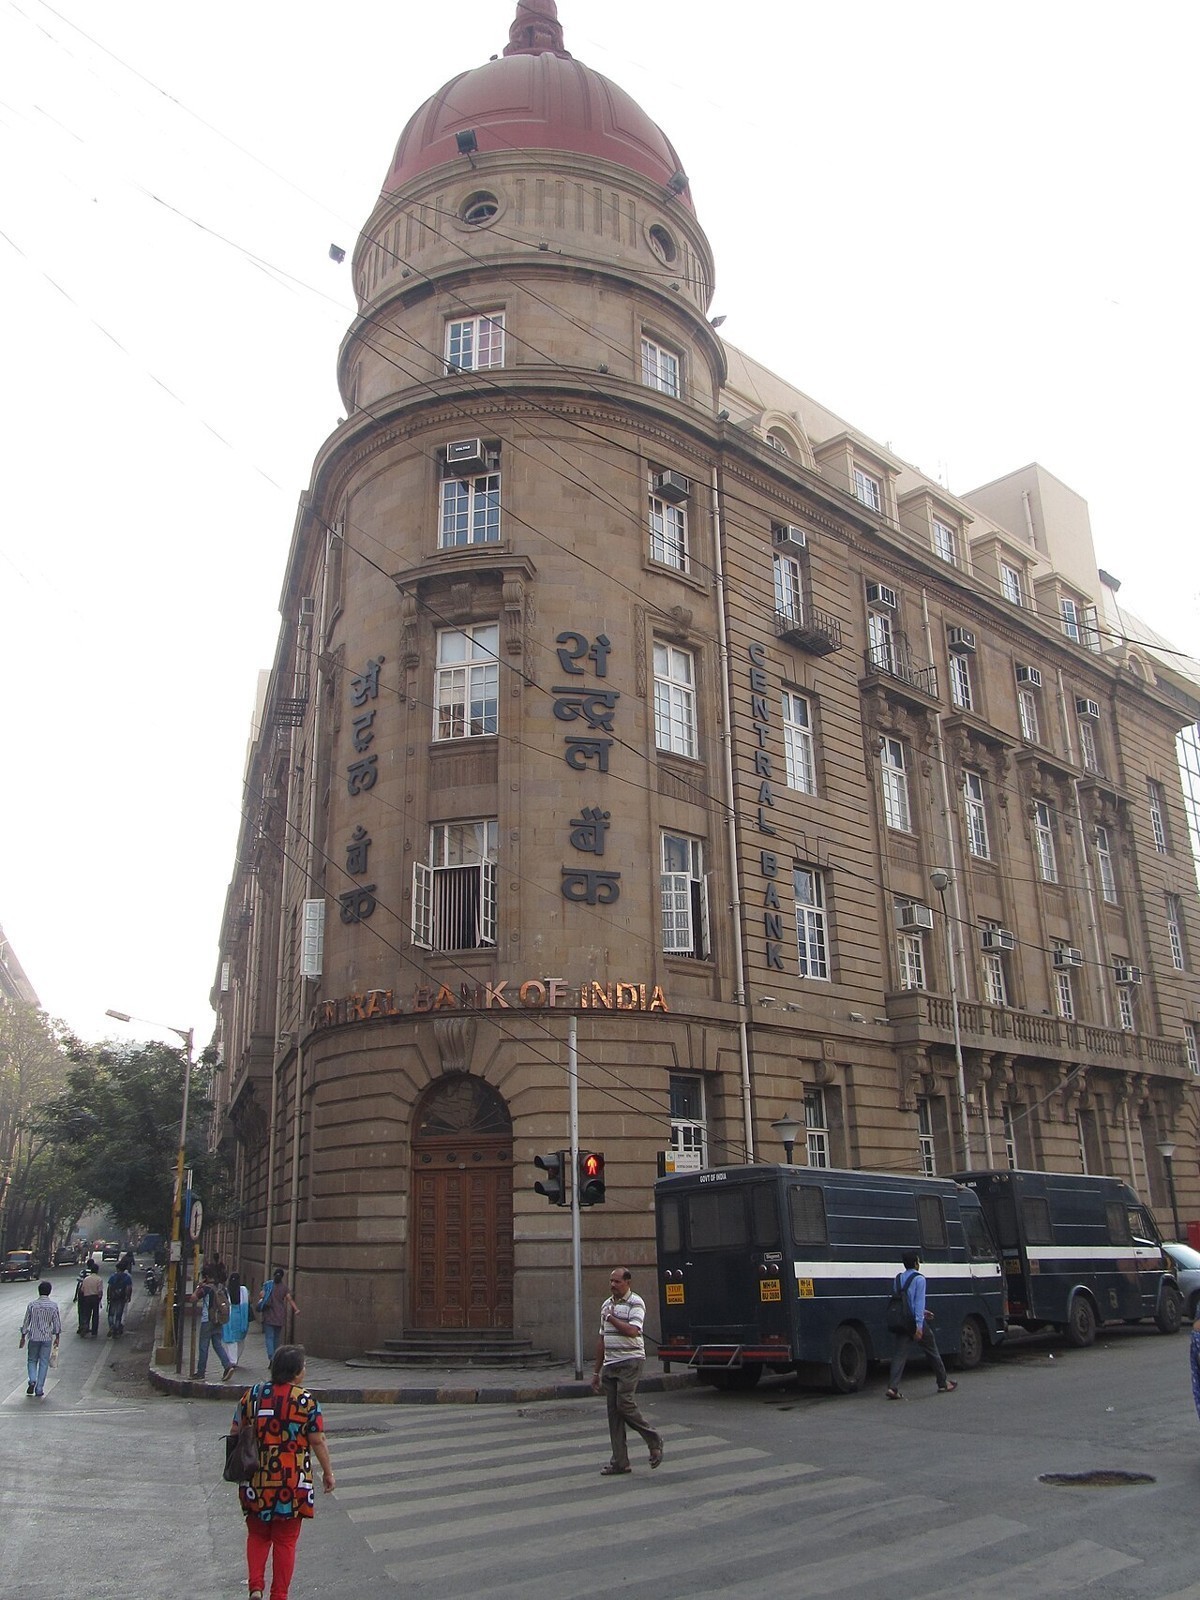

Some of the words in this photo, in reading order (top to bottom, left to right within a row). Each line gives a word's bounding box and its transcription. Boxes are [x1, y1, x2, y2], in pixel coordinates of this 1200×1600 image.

[749, 643, 776, 835] CENTRAL
[760, 851, 785, 970] BANK
[413, 980, 510, 1012] BANK
[519, 979, 568, 1009] OF
[581, 980, 669, 1012] INDIA
[699, 1174, 711, 1183] GOVT
[716, 1172, 727, 1180] INDIA
